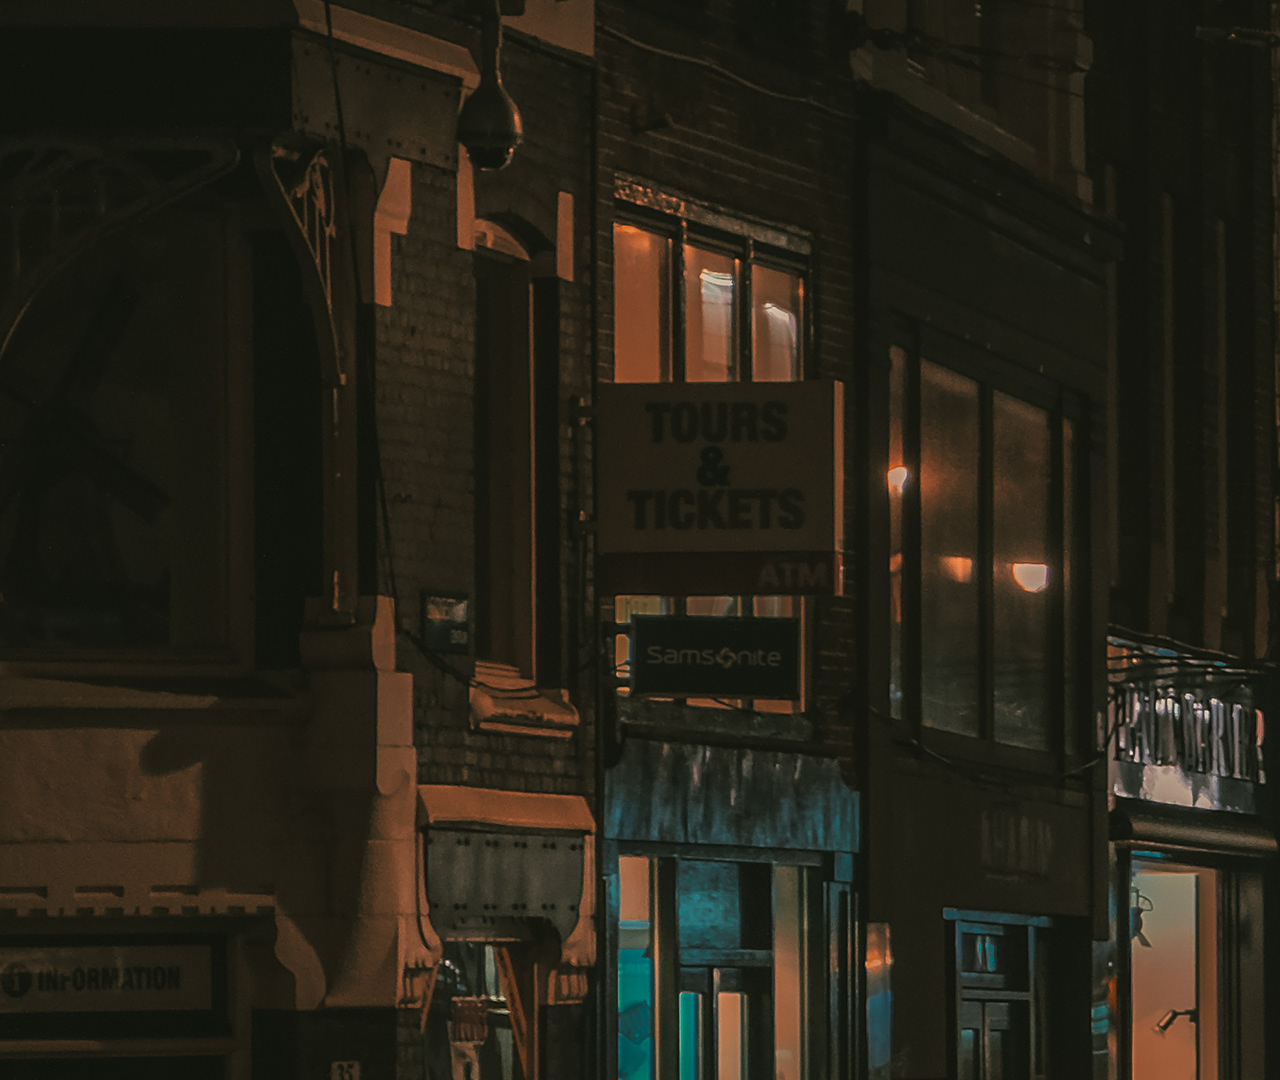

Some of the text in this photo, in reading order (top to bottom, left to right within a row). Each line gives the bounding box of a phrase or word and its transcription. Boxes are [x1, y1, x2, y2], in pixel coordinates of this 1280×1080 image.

[645, 401, 789, 443] TOURS
[696, 445, 731, 486] &
[626, 487, 806, 531] TICKETS
[758, 562, 829, 589] ATM
[646, 645, 783, 669] Samsonite
[37, 964, 182, 992] INFORMATION
